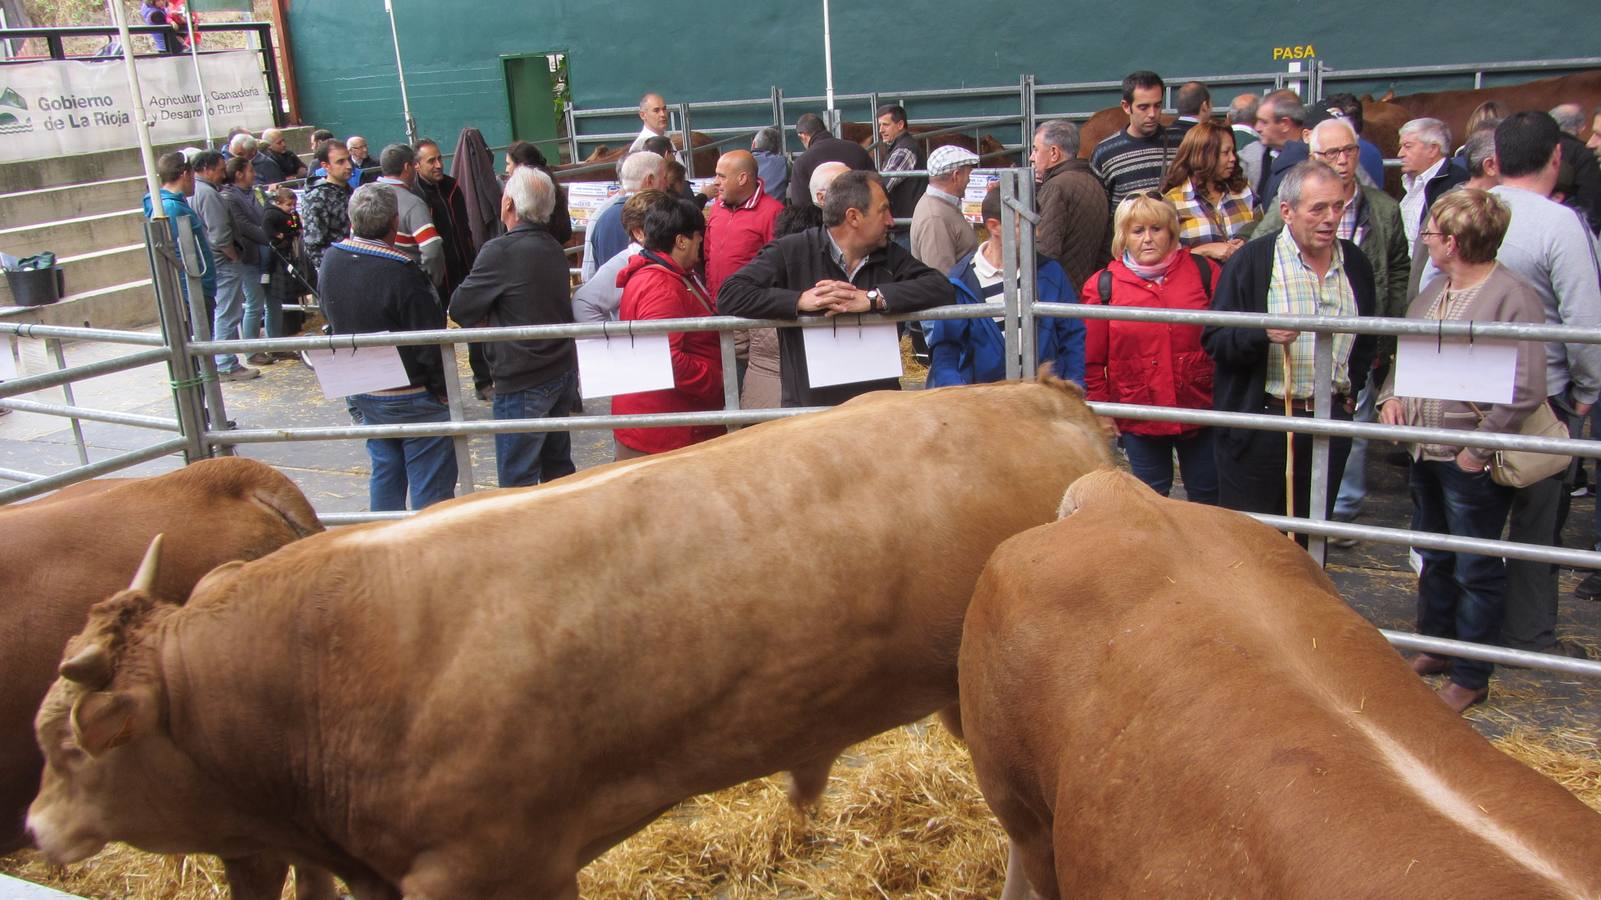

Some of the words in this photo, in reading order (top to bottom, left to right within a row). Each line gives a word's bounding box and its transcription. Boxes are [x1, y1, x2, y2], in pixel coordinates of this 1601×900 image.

[1273, 44, 1315, 60] PASA
[38, 94, 113, 111] Gobierno
[44, 116, 65, 131] de
[68, 114, 90, 128] La
[93, 110, 130, 127] Rioja
[161, 108, 215, 121] Desarroo
[217, 103, 244, 115] Rural
